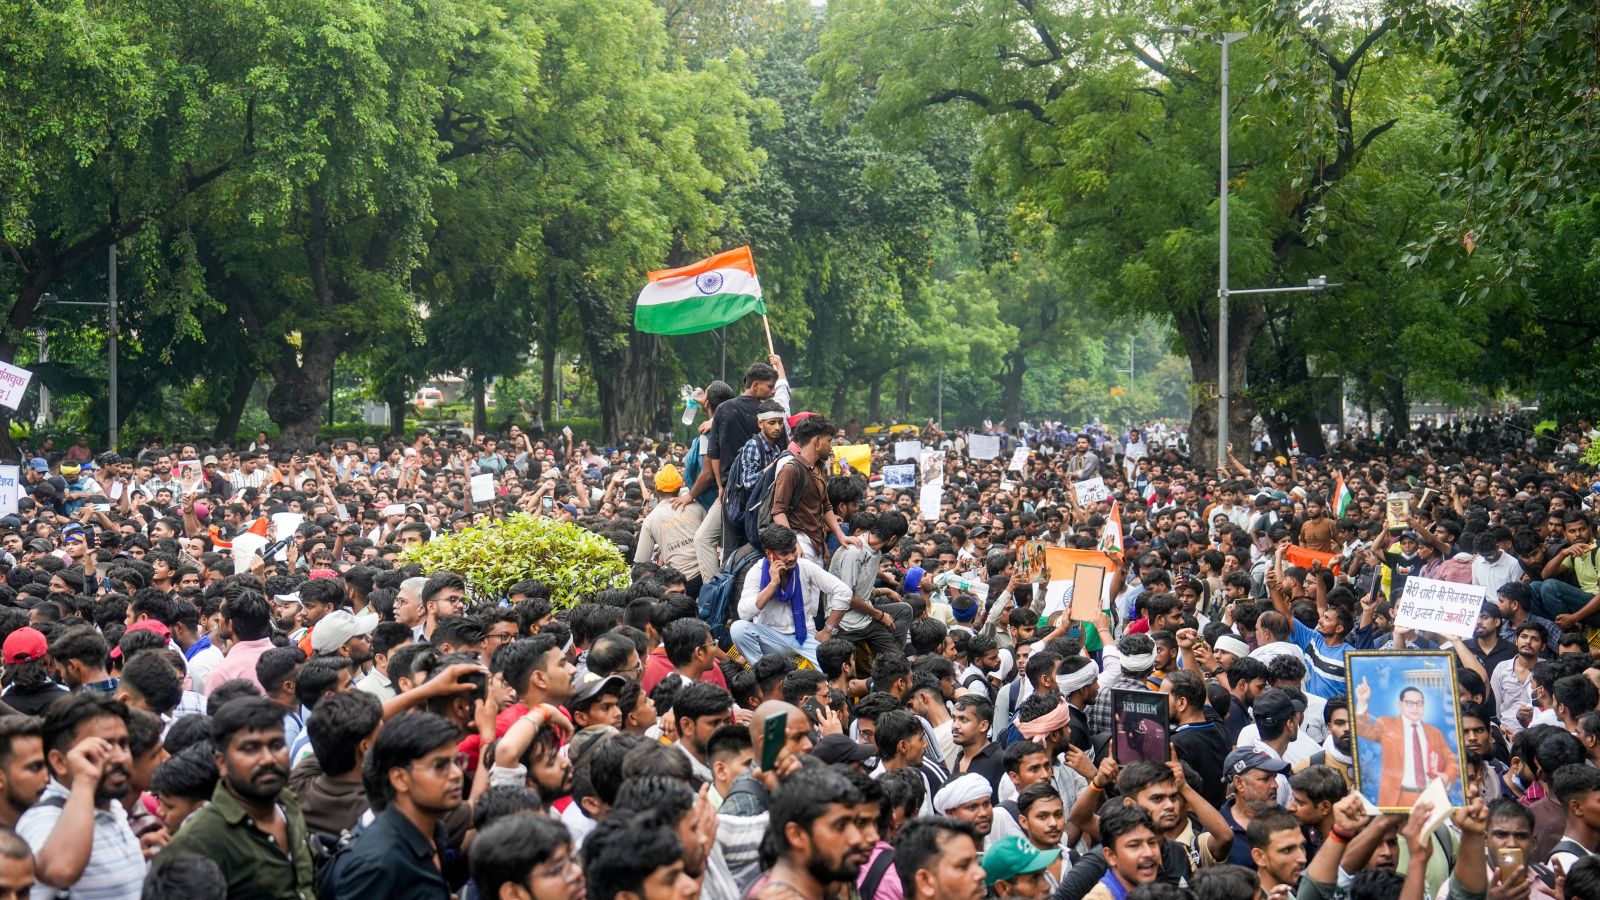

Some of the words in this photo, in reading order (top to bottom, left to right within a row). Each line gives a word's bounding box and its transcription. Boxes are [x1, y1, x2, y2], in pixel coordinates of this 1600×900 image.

[1406, 580, 1419, 597] मेरी
[1437, 586, 1446, 602] की
[1401, 601, 1415, 617] मेरी
[1434, 605, 1445, 621] तो
[1465, 610, 1475, 626] है
